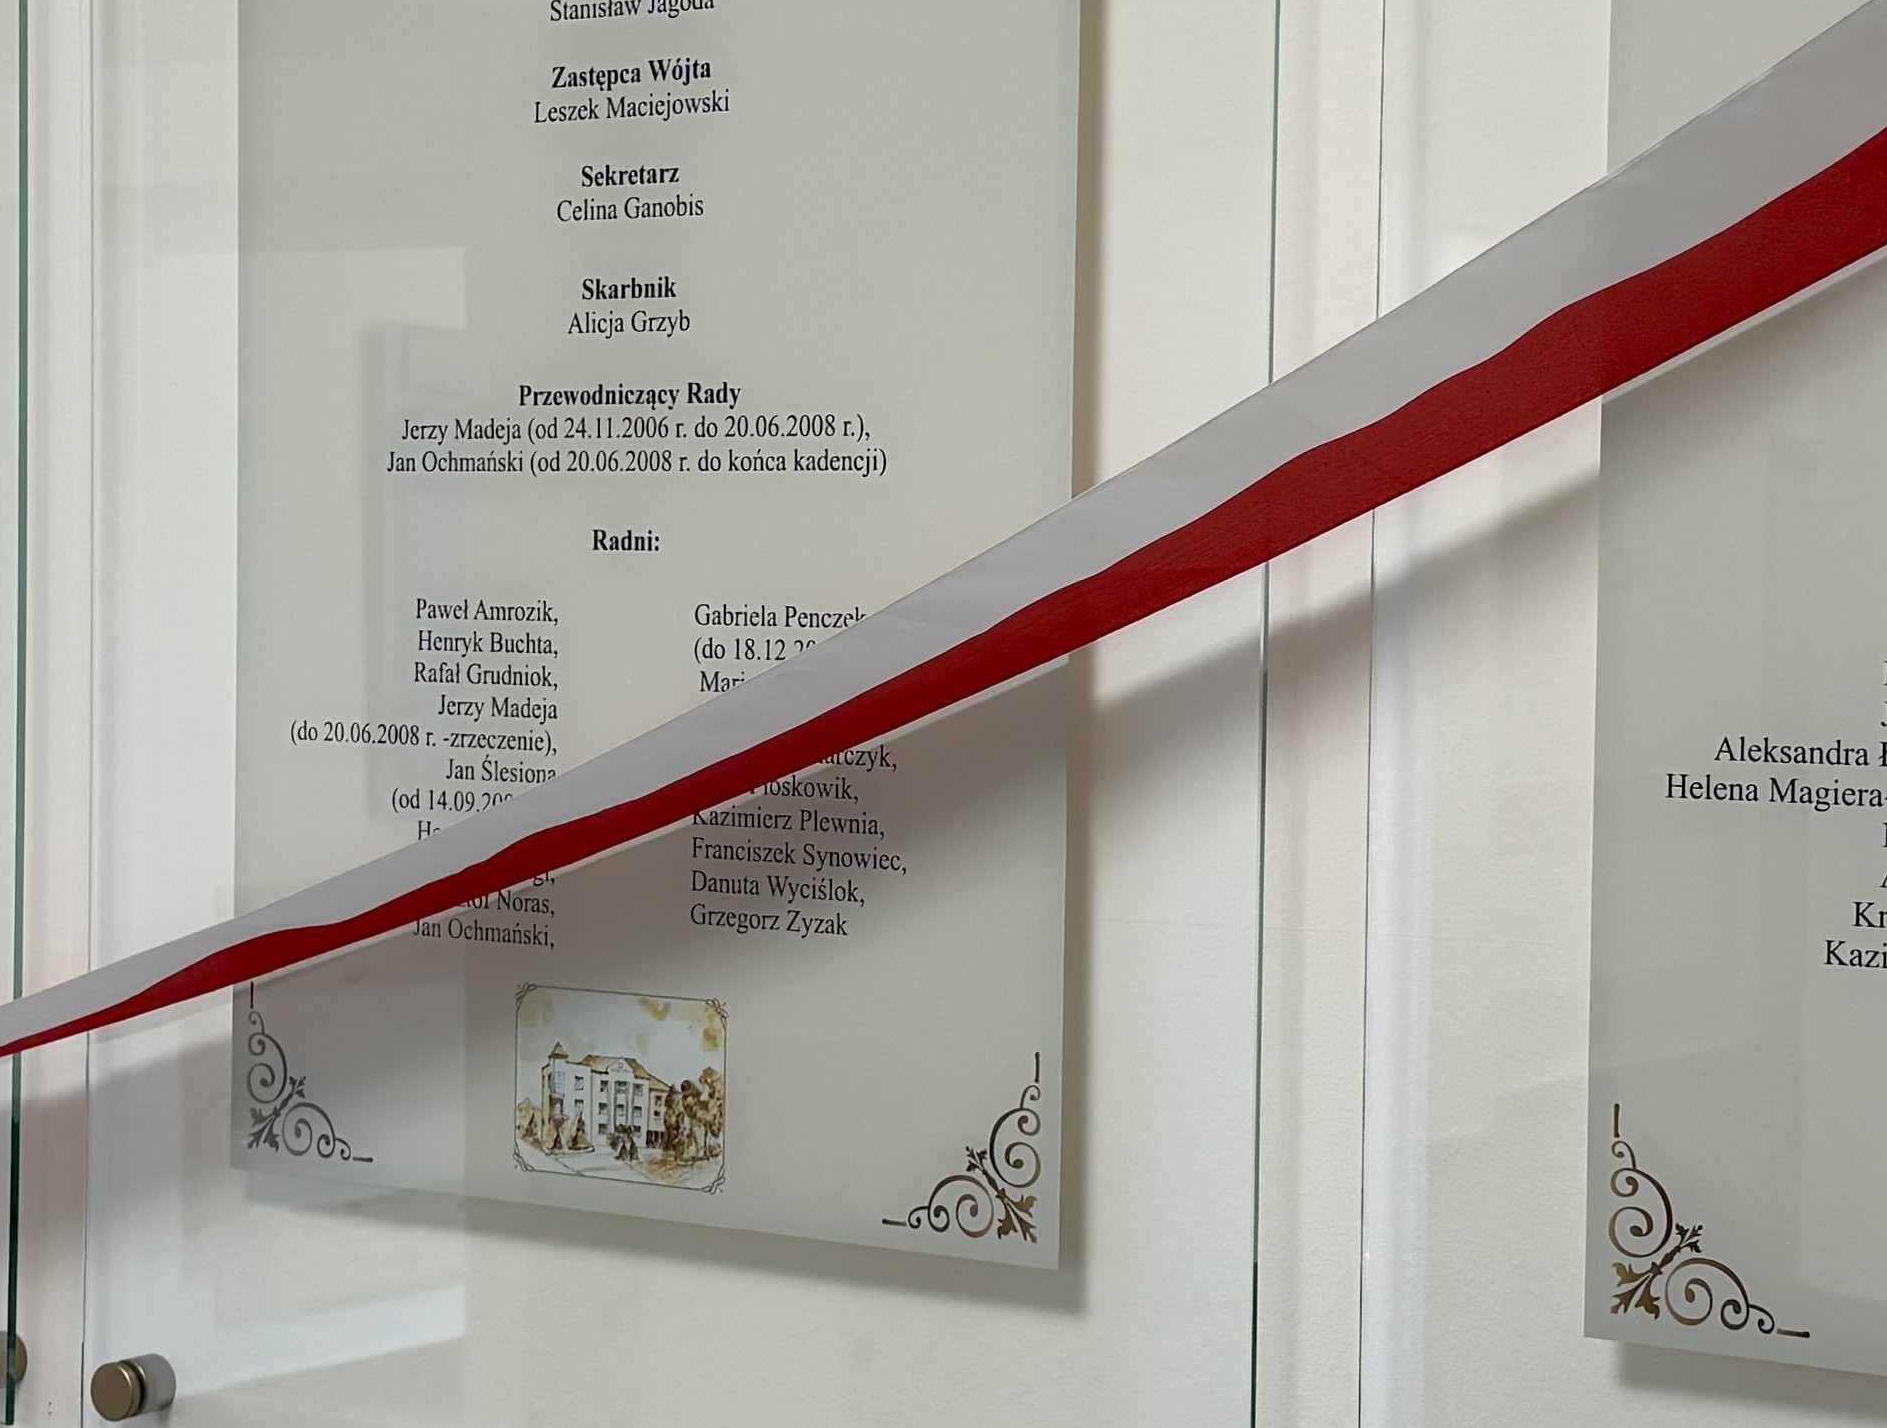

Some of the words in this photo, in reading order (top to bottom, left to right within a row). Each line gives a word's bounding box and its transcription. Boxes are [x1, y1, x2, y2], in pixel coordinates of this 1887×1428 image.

[552, 66, 641, 92] Zastępca
[648, 57, 711, 86] Wójta
[534, 97, 599, 123] Leszek
[606, 89, 729, 122] Maciejowski
[581, 164, 679, 187] Sekretarz
[557, 198, 618, 222] Celina
[624, 194, 704, 219] Ganobis
[582, 276, 677, 300] Skarbnik
[568, 312, 624, 339] Alicja
[631, 309, 690, 338] Grzyb
[519, 383, 680, 411] Przewodniczący
[687, 381, 741, 410] Rady
[402, 419, 448, 446] Jerzy
[455, 417, 521, 446] Madeja
[528, 417, 558, 445] (od
[564, 416, 669, 439] 24.11.2006
[676, 423, 687, 438] r.
[694, 415, 718, 438] do
[724, 414, 835, 437] 20.06.2008
[843, 414, 870, 442] r.),
[387, 451, 416, 472] Jan
[422, 450, 523, 472] Ochmański
[530, 450, 560, 477] (od
[566, 450, 672, 472] 20.06.2008
[679, 456, 690, 472] r.
[698, 449, 721, 472] do
[728, 448, 787, 472] końca
[794, 448, 887, 478] kadencji)
[592, 529, 659, 551] Radni:
[416, 598, 468, 620] Paweł
[473, 599, 558, 626] Amrozik,
[418, 630, 484, 658] Henryk
[490, 632, 558, 659] Buchta,
[414, 661, 461, 684] Rafał
[466, 663, 558, 691] Grudniok,
[438, 694, 485, 722] Jerzy
[491, 696, 557, 725] Madeja
[291, 720, 318, 745] (do
[324, 721, 419, 746] 20.06.2008
[426, 732, 436, 747] r.
[1714, 736, 1870, 766] Aleksandra
[1666, 773, 1759, 802] Helena
[692, 837, 796, 864] Franciszek
[803, 843, 907, 876] Synowiec,
[692, 870, 760, 896] Danuta
[767, 875, 865, 907] Wyciślok,
[690, 903, 780, 934] Grzegorz
[786, 910, 848, 939] Zyzak
